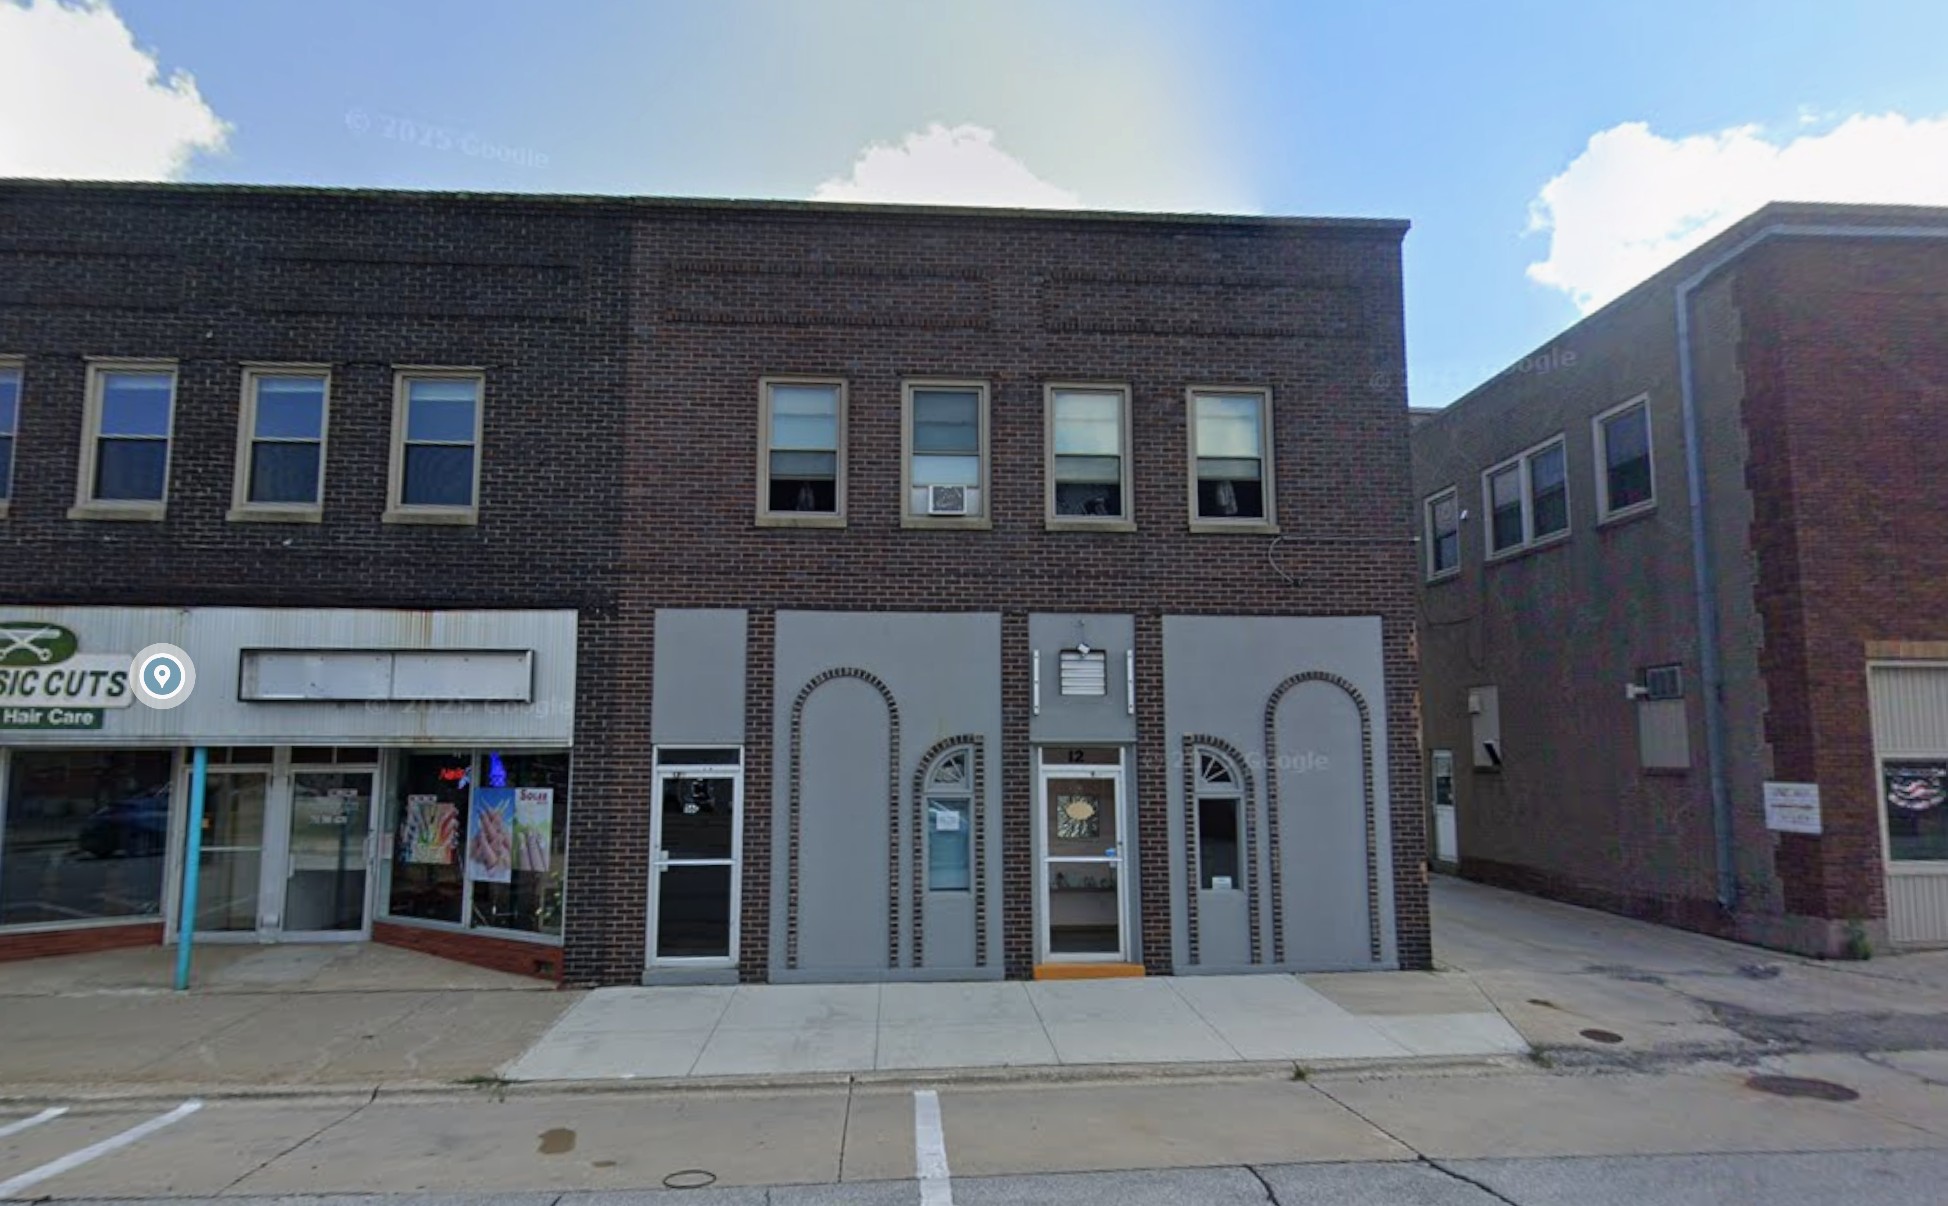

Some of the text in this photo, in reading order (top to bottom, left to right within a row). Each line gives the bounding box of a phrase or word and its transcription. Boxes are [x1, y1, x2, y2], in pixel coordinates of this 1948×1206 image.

[44, 670, 128, 697] CUTS
[3, 707, 94, 725] Hair Care
[1068, 750, 1084, 763] 12
